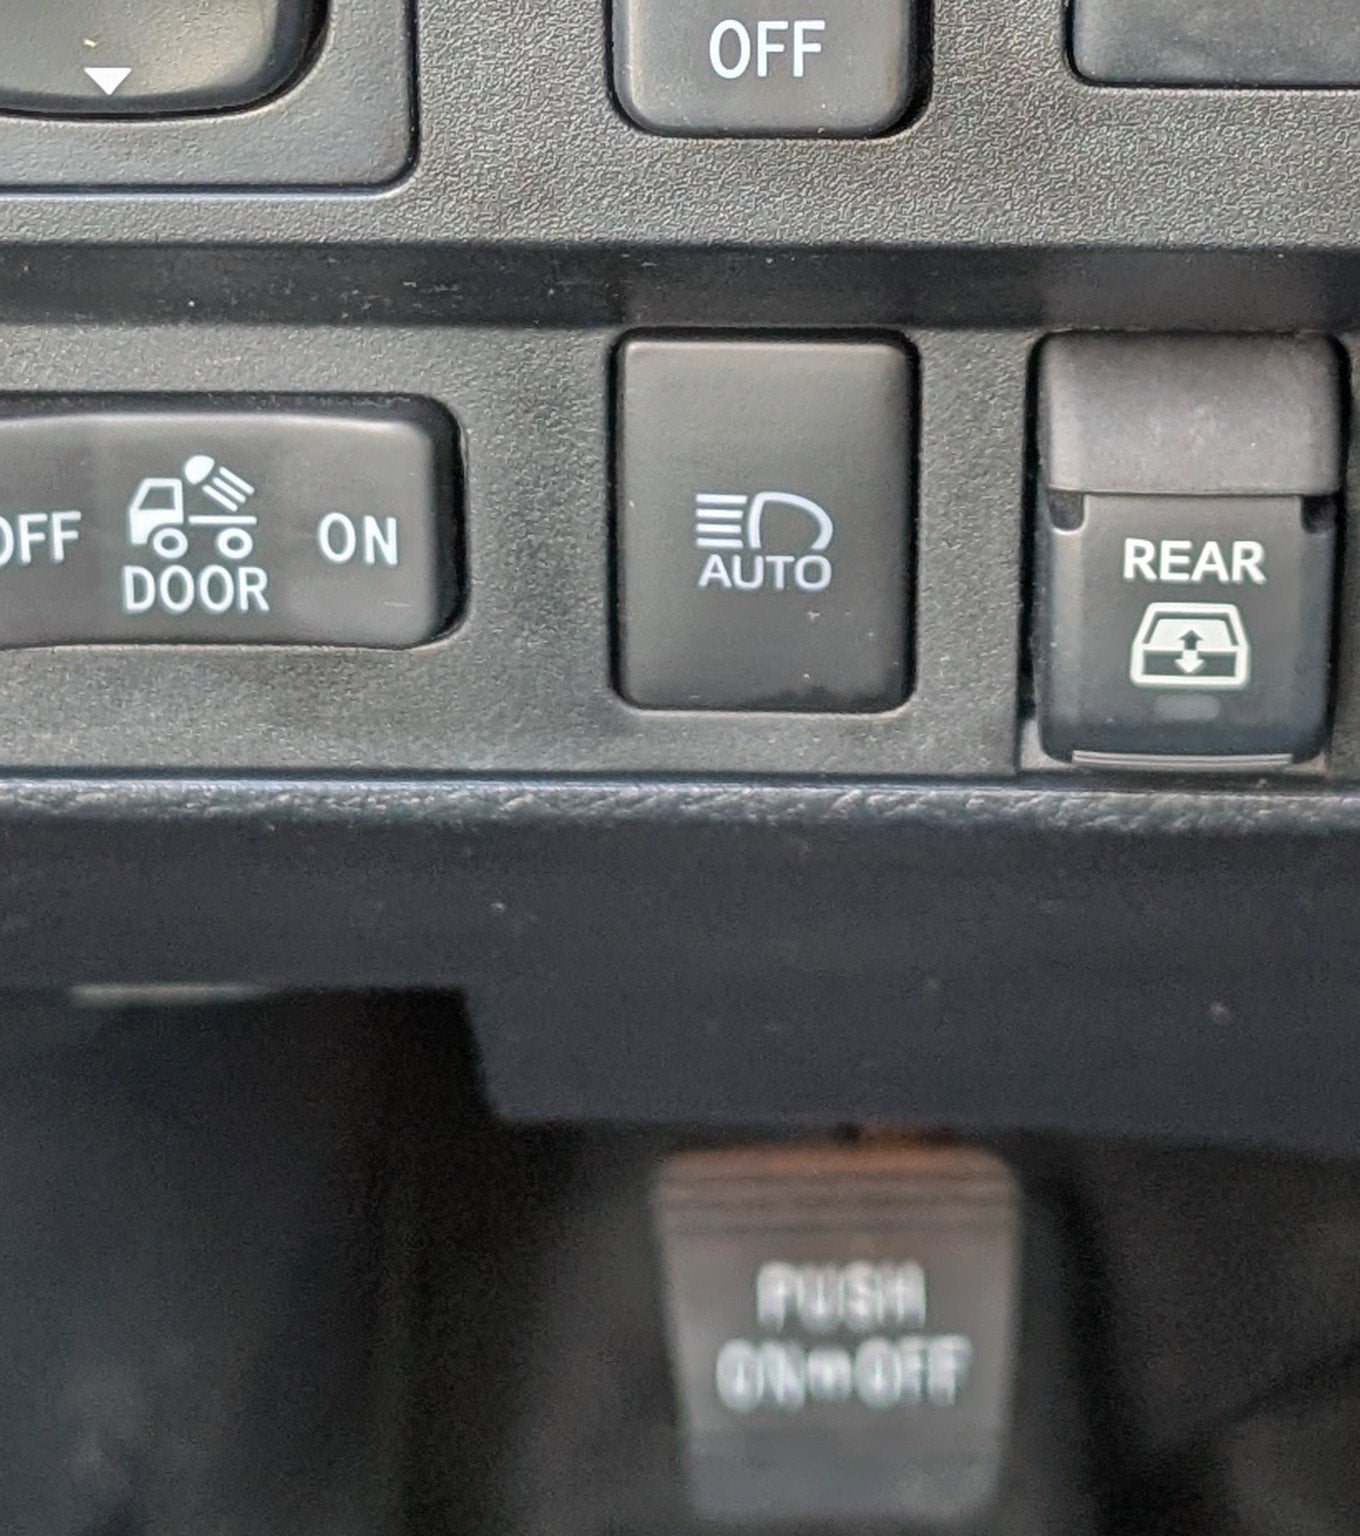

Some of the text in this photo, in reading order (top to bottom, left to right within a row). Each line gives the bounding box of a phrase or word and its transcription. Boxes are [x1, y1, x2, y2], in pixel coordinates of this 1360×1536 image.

[709, 20, 825, 78] OFF
[318, 513, 398, 565] ON
[1122, 538, 1267, 584] REAR
[123, 565, 270, 612] DOOR
[698, 554, 832, 589] AUTO
[757, 1260, 926, 1332] PUSH
